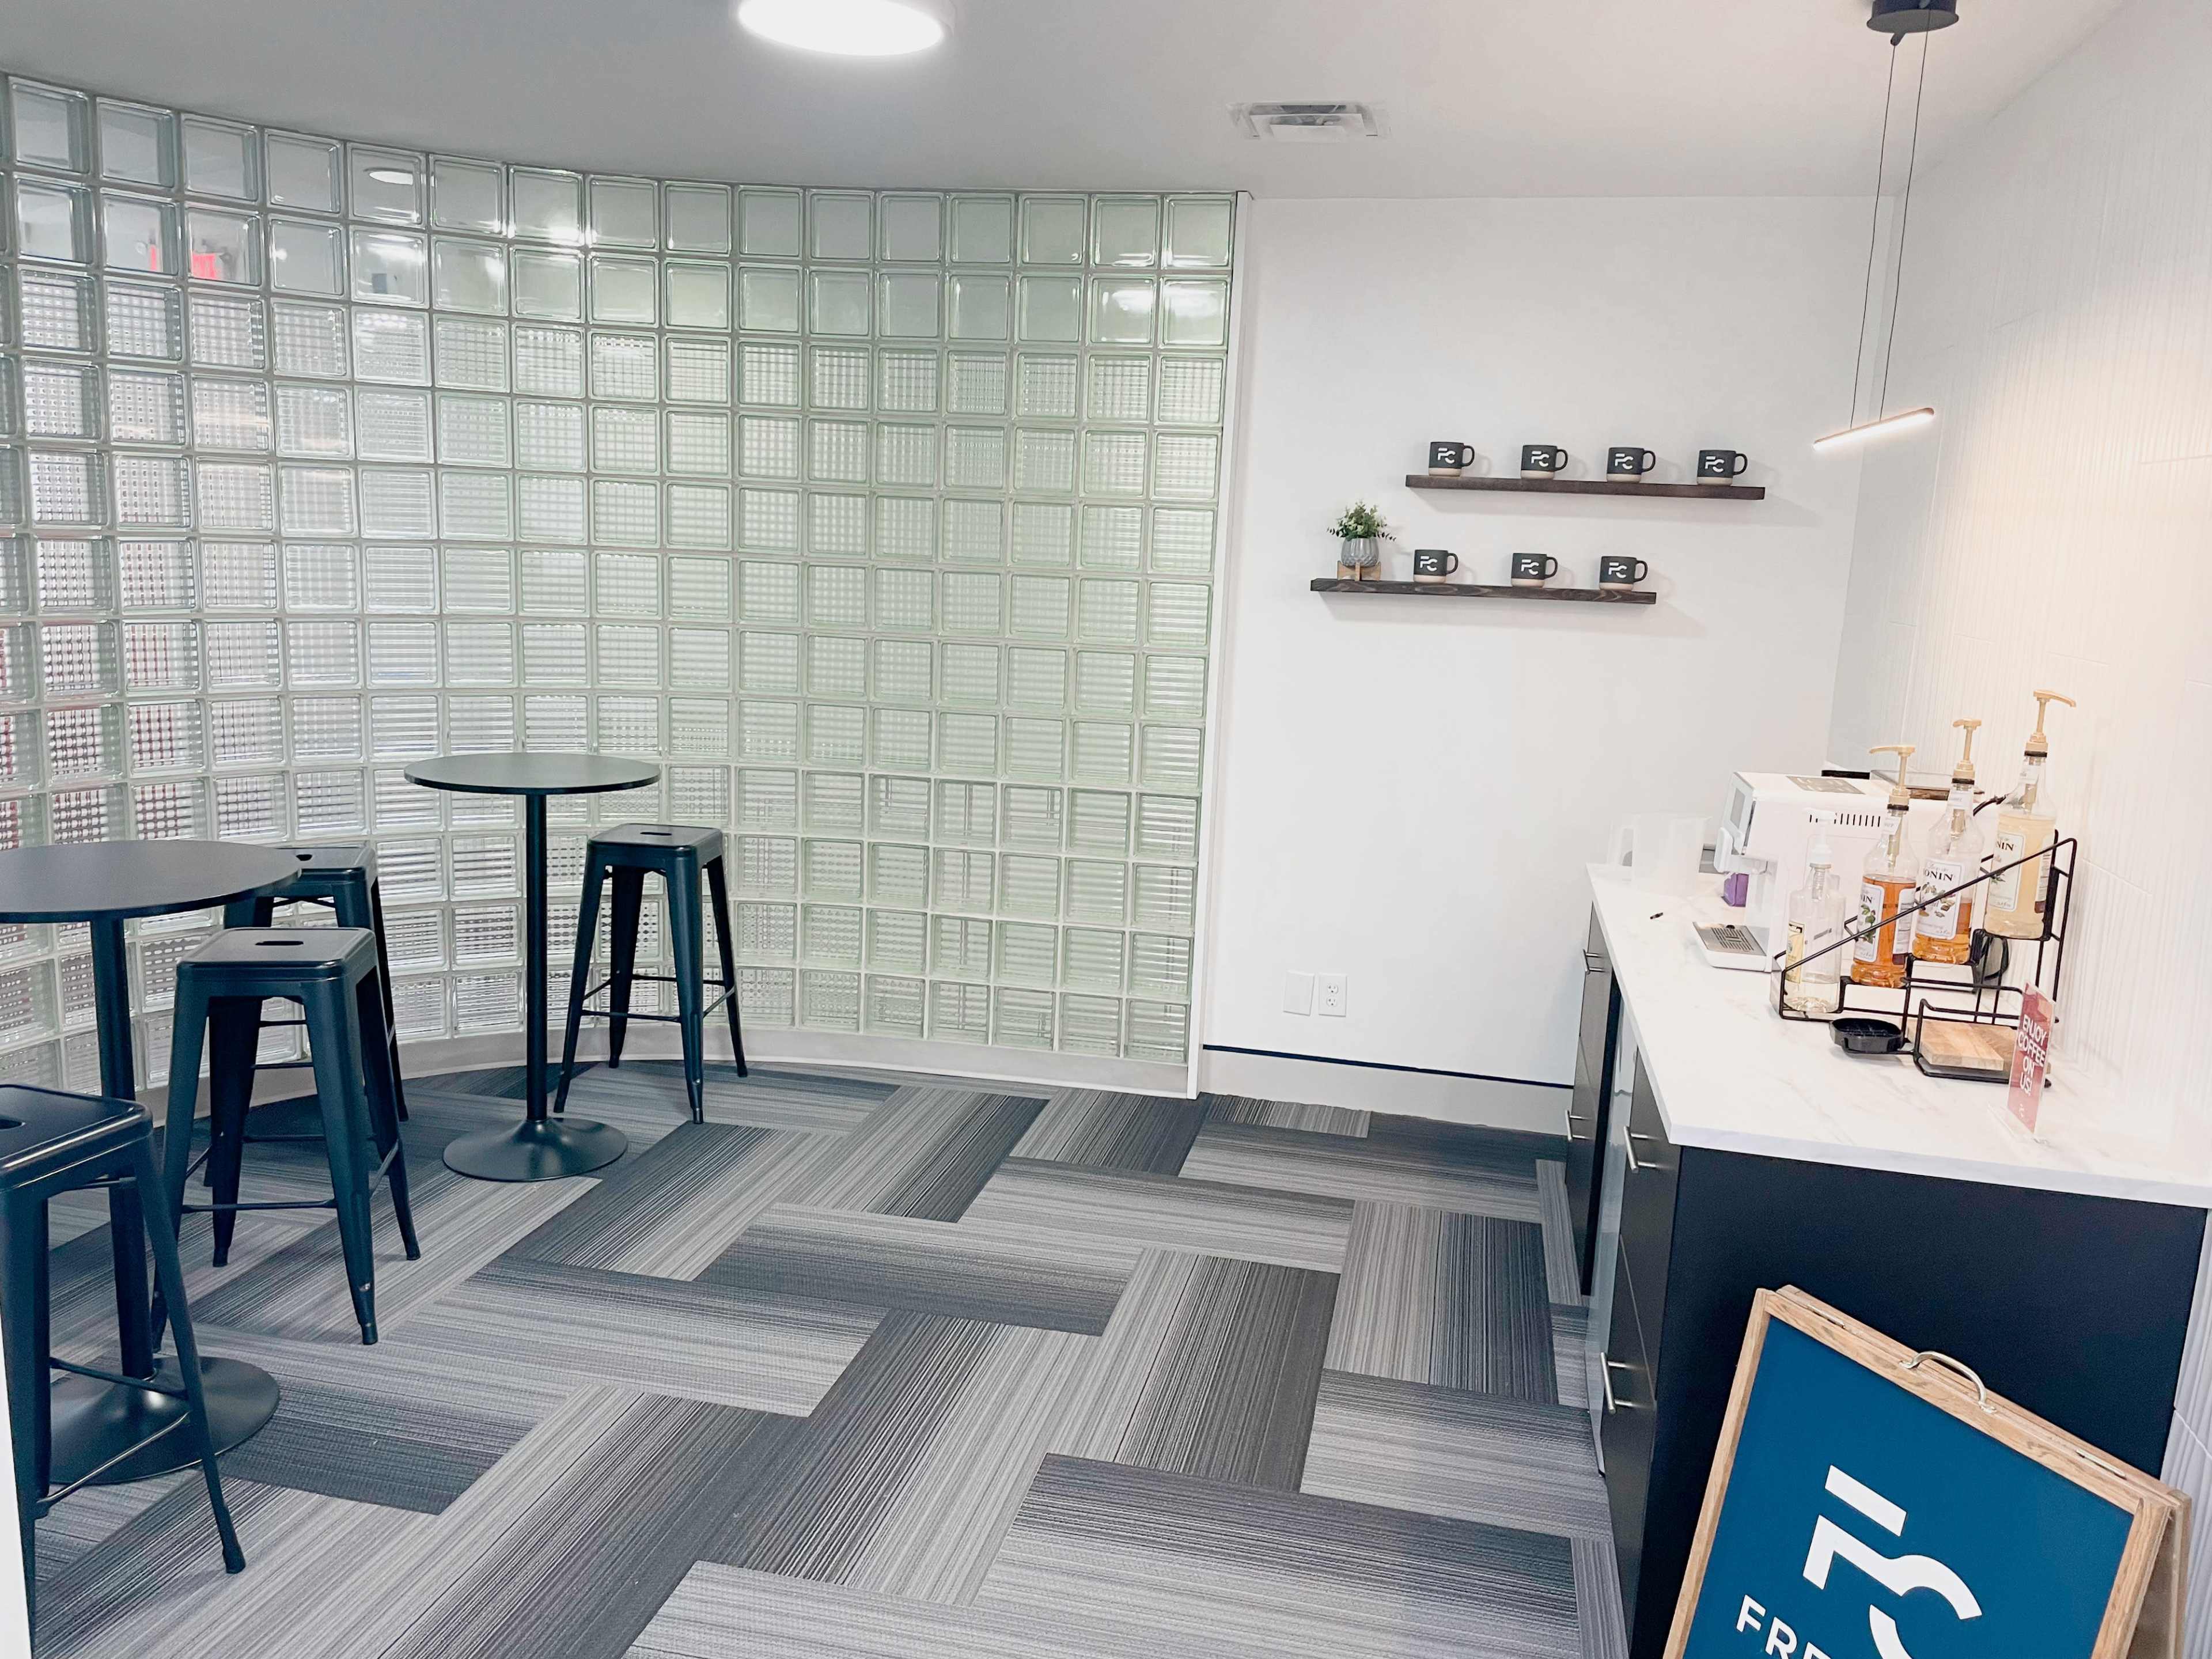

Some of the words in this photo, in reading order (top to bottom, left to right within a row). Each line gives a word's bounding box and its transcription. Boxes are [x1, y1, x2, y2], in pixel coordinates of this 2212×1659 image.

[1923, 869, 1953, 881] ONIN
[2022, 1014, 2047, 1046] ENJOY
[2018, 1032, 2046, 1067] COFFEE
[2022, 1056, 2035, 1078] ON
[2020, 1071, 2032, 1097] US!
